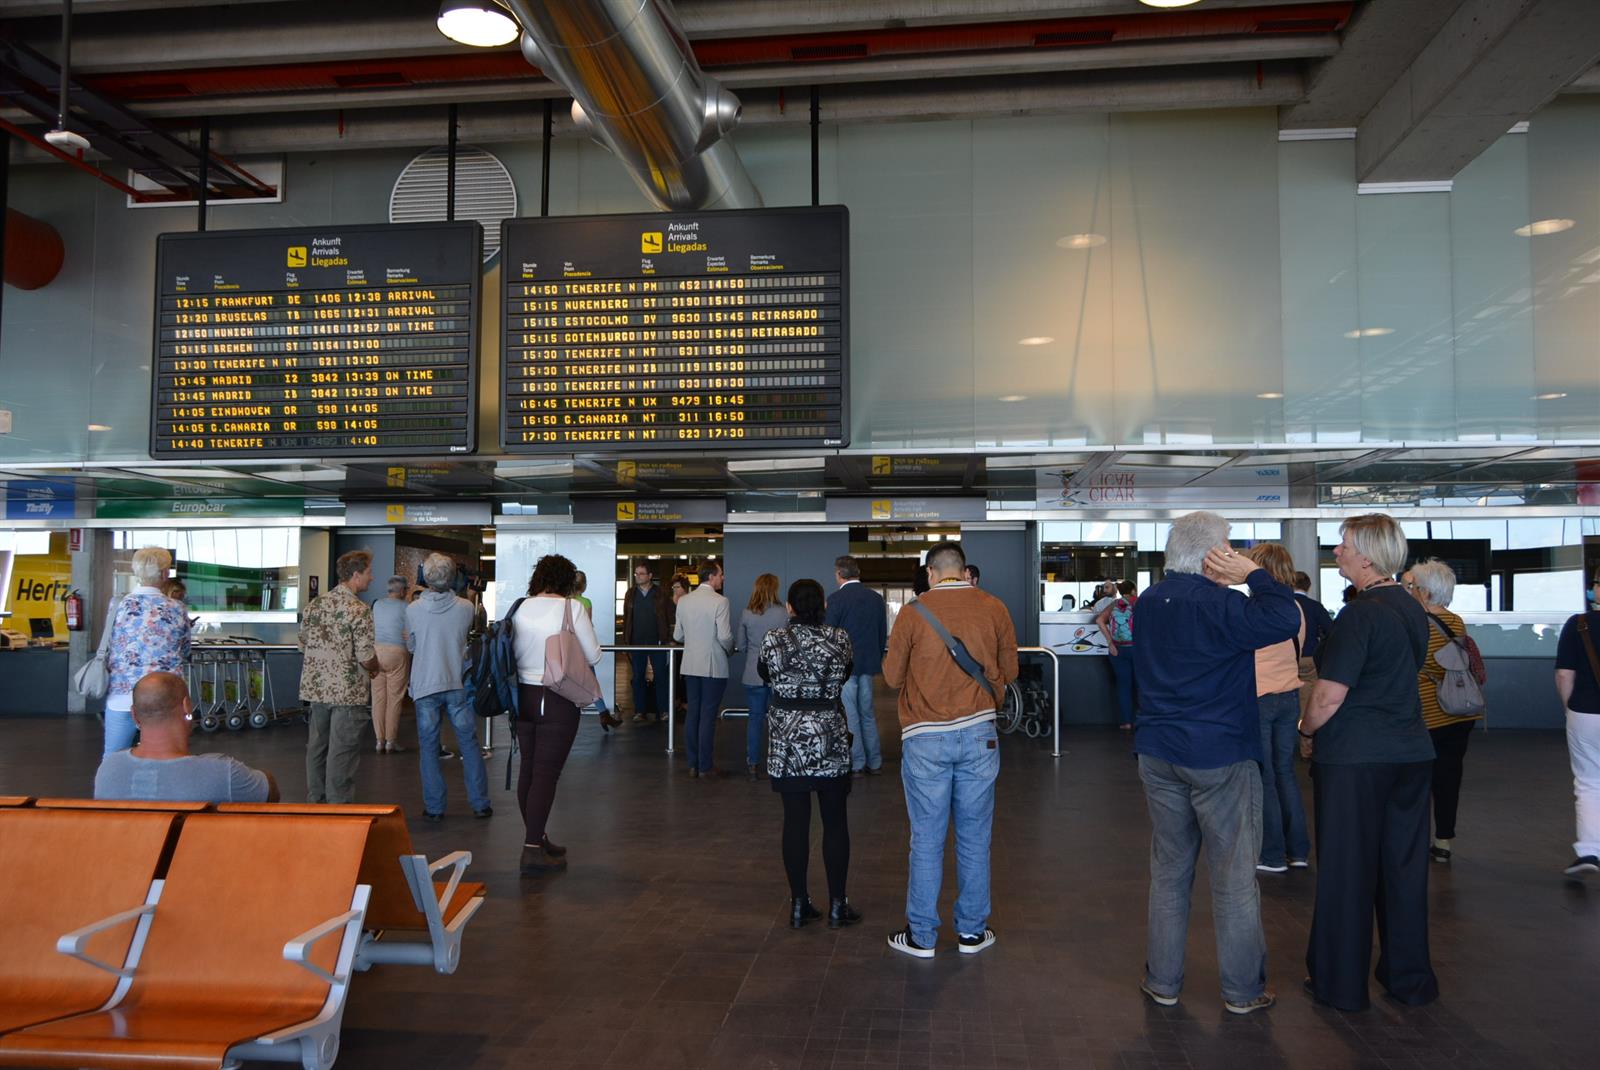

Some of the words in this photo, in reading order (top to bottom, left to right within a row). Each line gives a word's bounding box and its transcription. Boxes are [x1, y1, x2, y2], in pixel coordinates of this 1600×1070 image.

[668, 223, 698, 231] Ankunft
[312, 238, 340, 246] Ankunft
[668, 232, 697, 241] Arrivals
[668, 243, 707, 253] Llegadas
[312, 257, 348, 267] Llegadas
[524, 285, 558, 295] 14:50
[565, 284, 620, 293] TENERIFE
[629, 282, 635, 292] N
[644, 281, 656, 291] PM
[709, 279, 743, 289] 14:50
[176, 298, 208, 308] 12:15
[215, 296, 273, 306] FRANKFURT
[288, 295, 300, 304] DE
[348, 292, 381, 302] 12:38
[388, 291, 435, 300] ARRIVAL
[524, 302, 558, 311] 15:15
[565, 300, 628, 310] NUREMBERG
[643, 298, 656, 308] ST
[709, 296, 743, 305] 15:15
[176, 314, 208, 324] 12:20
[214, 312, 266, 322] BRUSELAS
[287, 311, 300, 320] TB
[347, 308, 380, 318] 12:31
[388, 307, 434, 316] ARRIVAL
[524, 318, 557, 327] 15:15
[565, 316, 628, 326] ESTOCOLMO
[643, 314, 656, 324] DY
[709, 312, 743, 322] 15:45
[752, 310, 817, 320] RETRASADO
[176, 330, 207, 339] 12:50
[214, 328, 252, 338] MUNICH
[287, 327, 300, 336] DE
[387, 323, 400, 332] ON
[408, 323, 434, 332] TIME
[524, 334, 557, 344] 15:15
[565, 332, 634, 342] GOTEMBURGO
[643, 331, 656, 340] DY
[709, 329, 743, 339] 15:45
[752, 327, 817, 337] RETRASADO
[175, 345, 207, 355] 13:15
[214, 344, 252, 353] BREMEN
[286, 343, 299, 352] ST
[346, 340, 379, 350] 13:00
[524, 350, 557, 360] 15:30
[565, 349, 620, 358] TENERIFE
[629, 348, 635, 357] N
[643, 347, 656, 357] NT
[709, 346, 743, 355] 15:30
[174, 361, 206, 370] 13:30
[213, 360, 265, 369] TENERIFE
[272, 359, 278, 367] N
[286, 359, 298, 367] NT
[346, 356, 379, 366] 13:30
[524, 366, 557, 376] 15:30
[565, 365, 620, 375] TENERIFE
[629, 364, 635, 374] N
[643, 364, 656, 373] IB
[709, 362, 743, 372] 15:30
[174, 377, 206, 386] 13:45
[212, 376, 251, 385] MADRID
[285, 374, 298, 383] I2
[346, 372, 378, 382] 13:39
[386, 370, 399, 380] ON
[407, 370, 433, 380] TIME
[523, 383, 557, 392] 16:30
[565, 382, 620, 391] TENERIFE
[628, 381, 635, 390] N
[643, 380, 656, 390] NT
[709, 379, 743, 388] 16:30
[174, 392, 205, 402] 13:45
[212, 391, 250, 400] MADRID
[285, 390, 298, 399] IB
[345, 388, 378, 397] 13:39
[386, 386, 398, 396] ON
[407, 386, 433, 396] TIME
[523, 399, 557, 408] 16:45
[565, 398, 620, 407] TENERIFE
[628, 397, 635, 406] N
[643, 397, 656, 406] UX
[709, 396, 743, 405] 16:45
[173, 408, 205, 417] 14:05
[212, 407, 270, 416] EINDHOVEN
[284, 406, 297, 415] OR
[345, 404, 378, 413] 14:05
[523, 415, 557, 425] 16:50
[565, 414, 627, 424] G.CANARIA
[643, 414, 656, 423] NT
[709, 412, 743, 422] 16:50
[172, 424, 204, 433] 14:05
[211, 423, 269, 432] G.CANARIA
[284, 422, 296, 431] OR
[344, 420, 377, 429] 14:05
[523, 431, 556, 441] 17:30
[565, 430, 620, 440] TENERIFE
[628, 430, 635, 439] N
[643, 430, 656, 439] NT
[709, 429, 743, 438] 17:30
[172, 440, 204, 448] 14:40
[210, 439, 262, 447] TENERIFE
[1089, 488, 1135, 501] CICAR
[26, 503, 54, 514] Thrifty
[172, 502, 226, 513] Europcar
